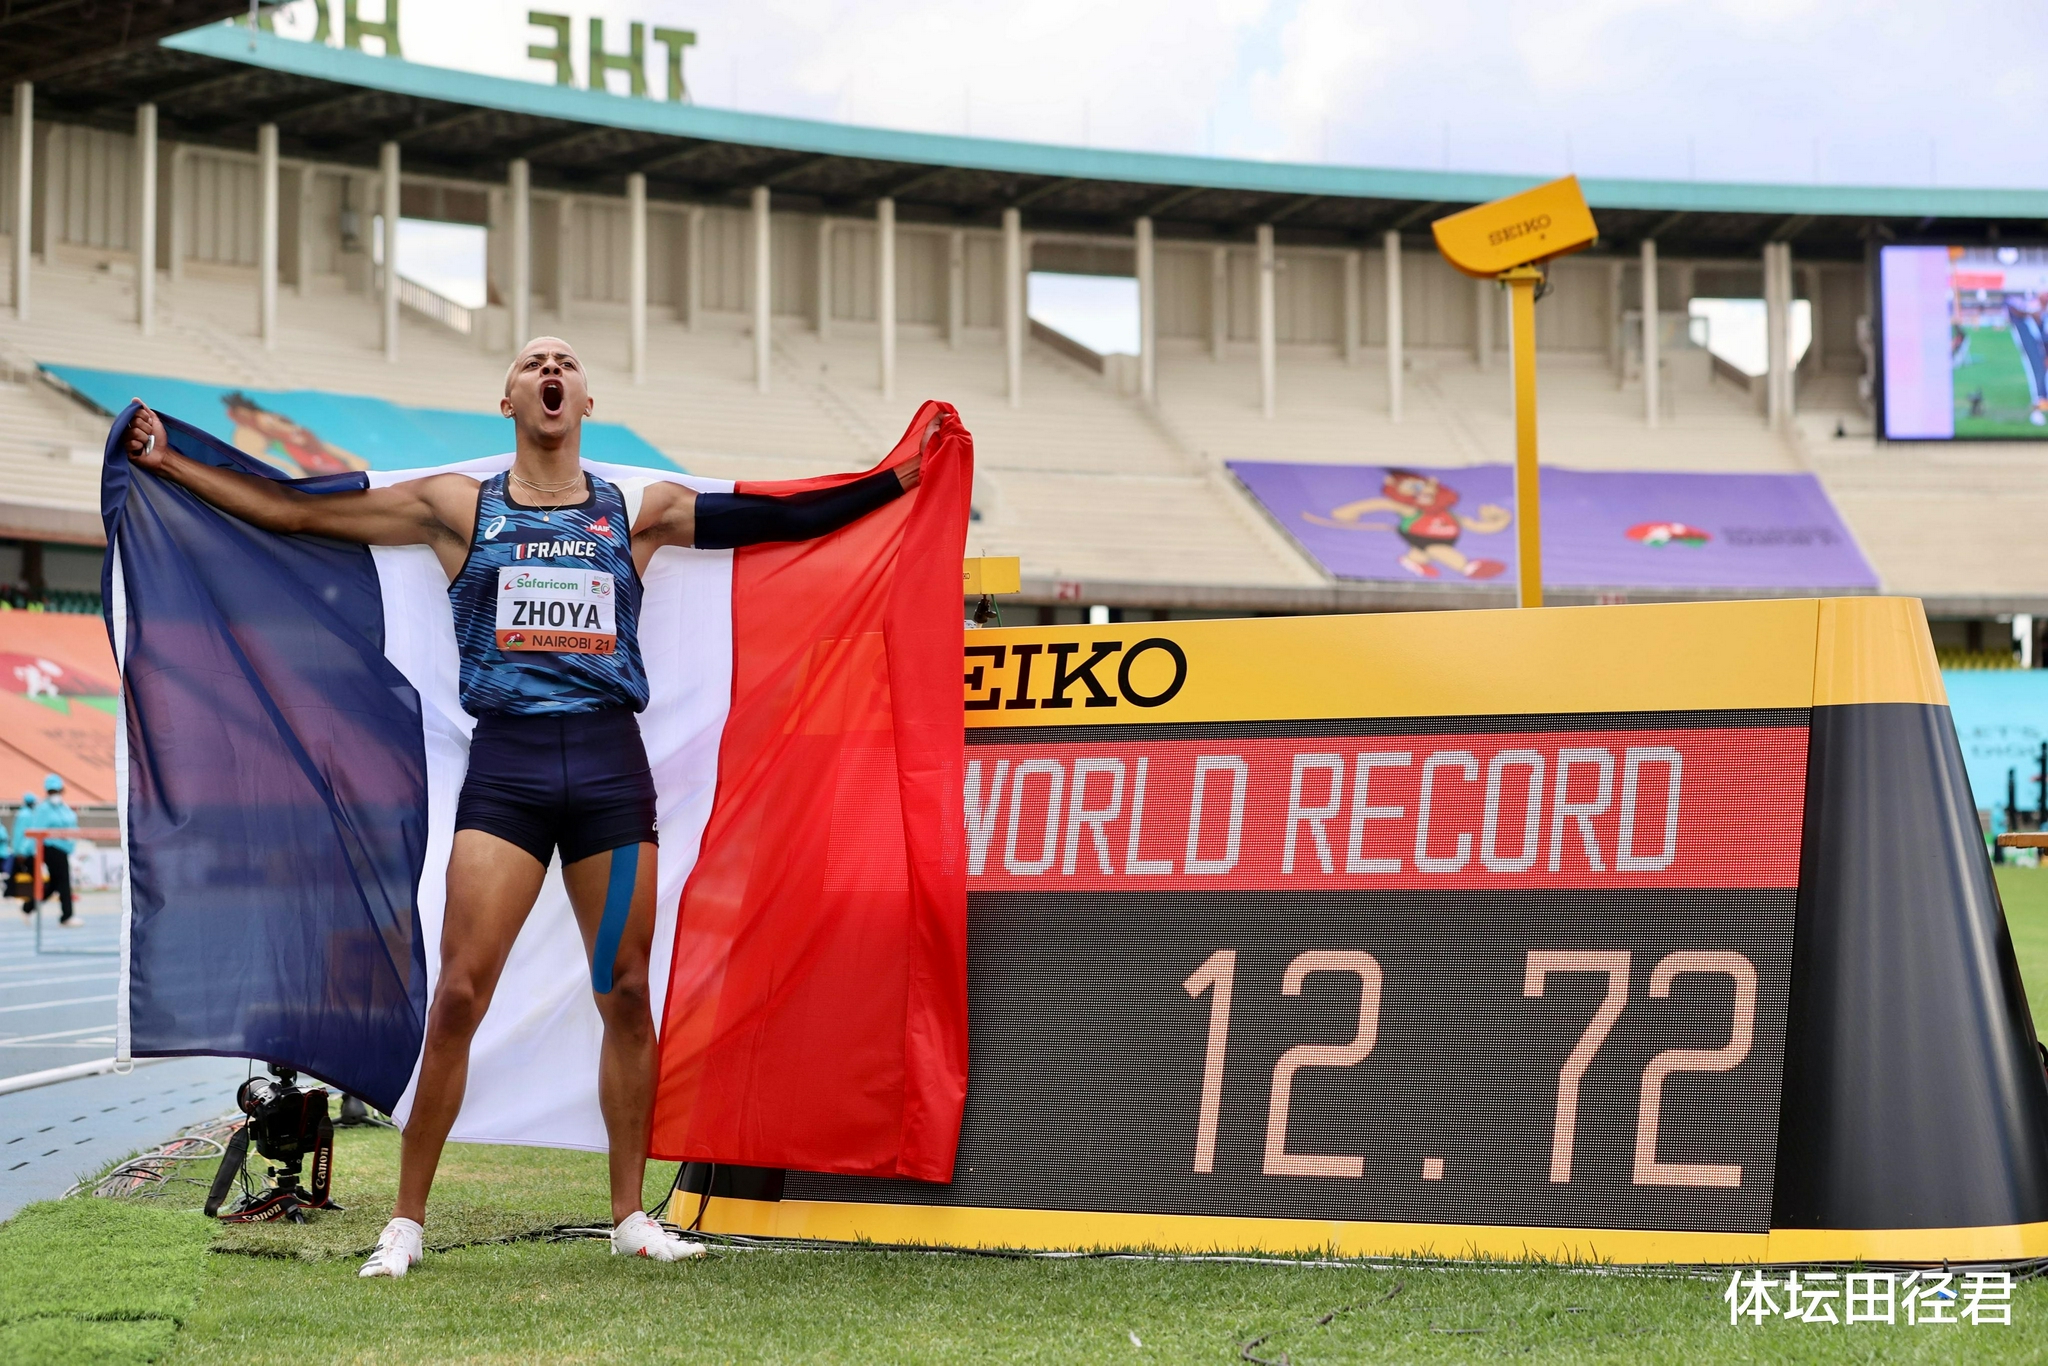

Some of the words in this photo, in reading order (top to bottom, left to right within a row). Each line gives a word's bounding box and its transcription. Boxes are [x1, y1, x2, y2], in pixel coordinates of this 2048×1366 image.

[1488, 213, 1552, 246] SEIKO
[590, 524, 610, 533] MAIF
[526, 540, 597, 559] FRANCE
[517, 577, 578, 591] Safaricom
[512, 600, 602, 630] ZHOYA
[532, 634, 592, 650] NAIROBI
[595, 638, 611, 652] 21
[964, 637, 1188, 711] EIKO
[942, 755, 1249, 876] WORLD
[1281, 746, 1683, 875] RECORD
[1182, 949, 1757, 1187] 12.72
[315, 1147, 329, 1190] Canon
[242, 1203, 282, 1222] Canon
